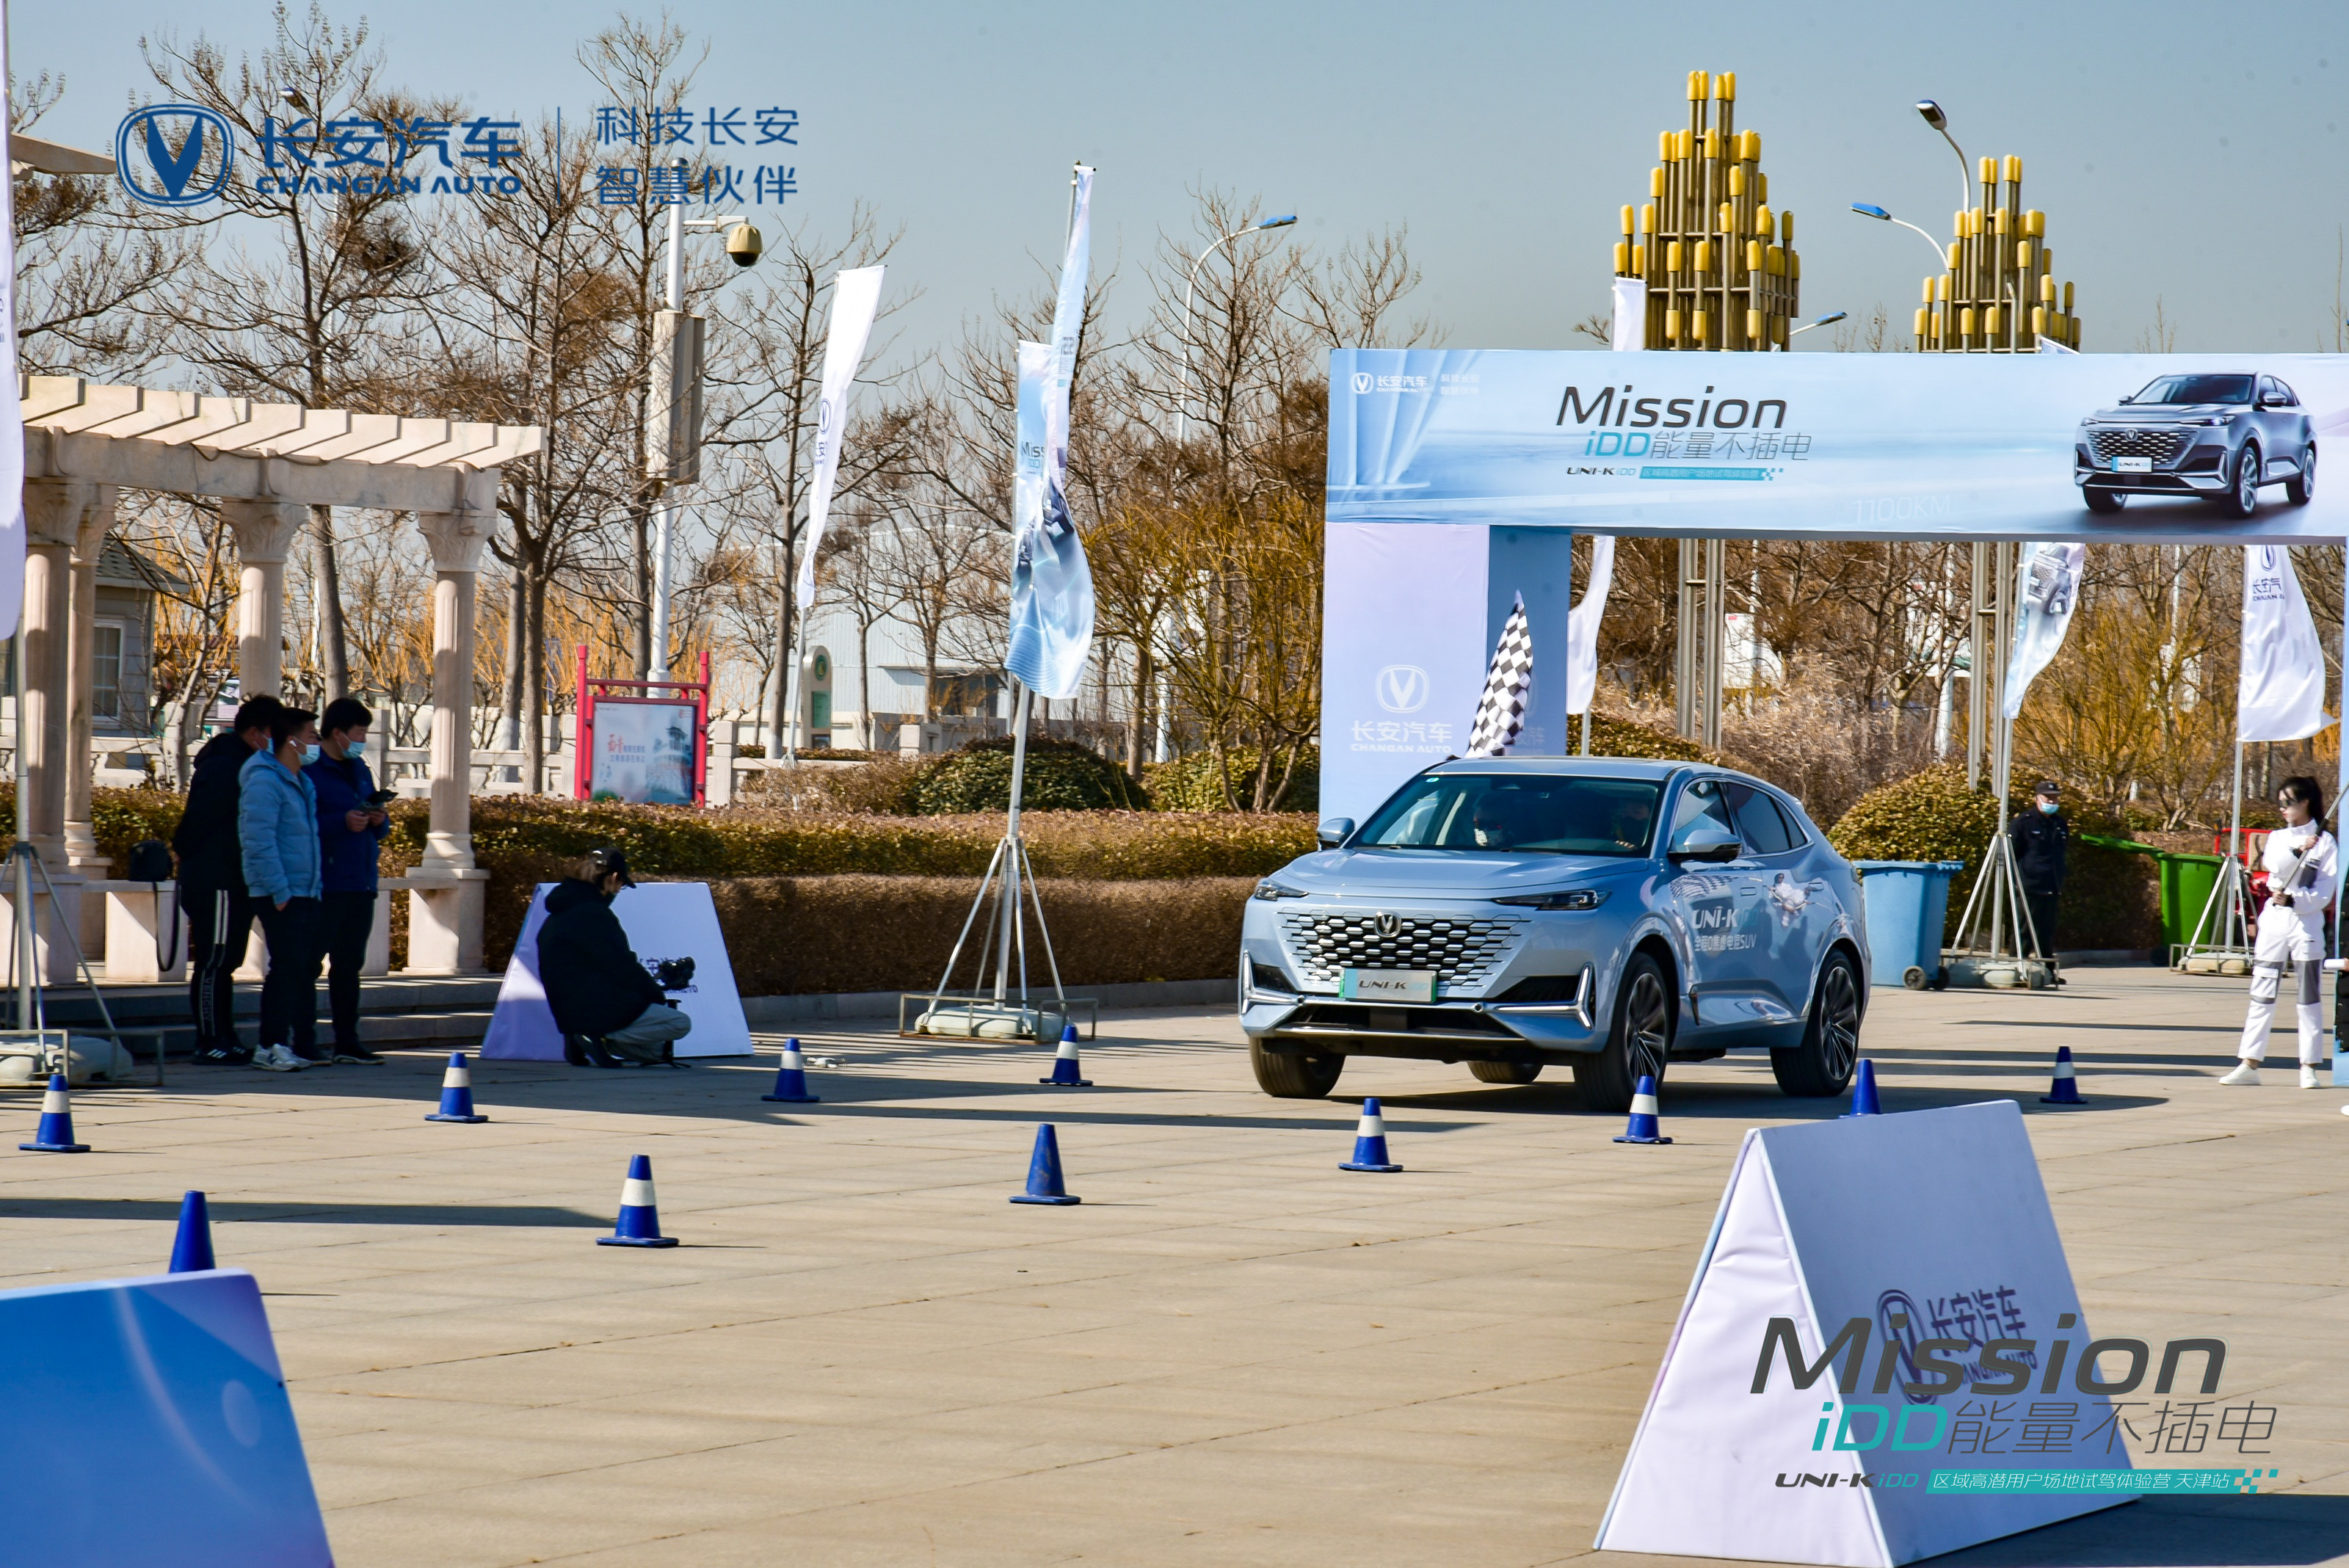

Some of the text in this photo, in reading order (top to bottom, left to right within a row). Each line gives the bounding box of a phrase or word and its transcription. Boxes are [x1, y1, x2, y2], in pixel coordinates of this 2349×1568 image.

[1377, 375, 1428, 387] 长安汽车
[1556, 385, 1787, 429] Mission
[1351, 720, 1453, 743] 长安汽车
[1351, 744, 1452, 753] CHANGAN AUTO
[1692, 909, 1739, 929] UNI-K
[1359, 980, 1407, 990] UNI-K
